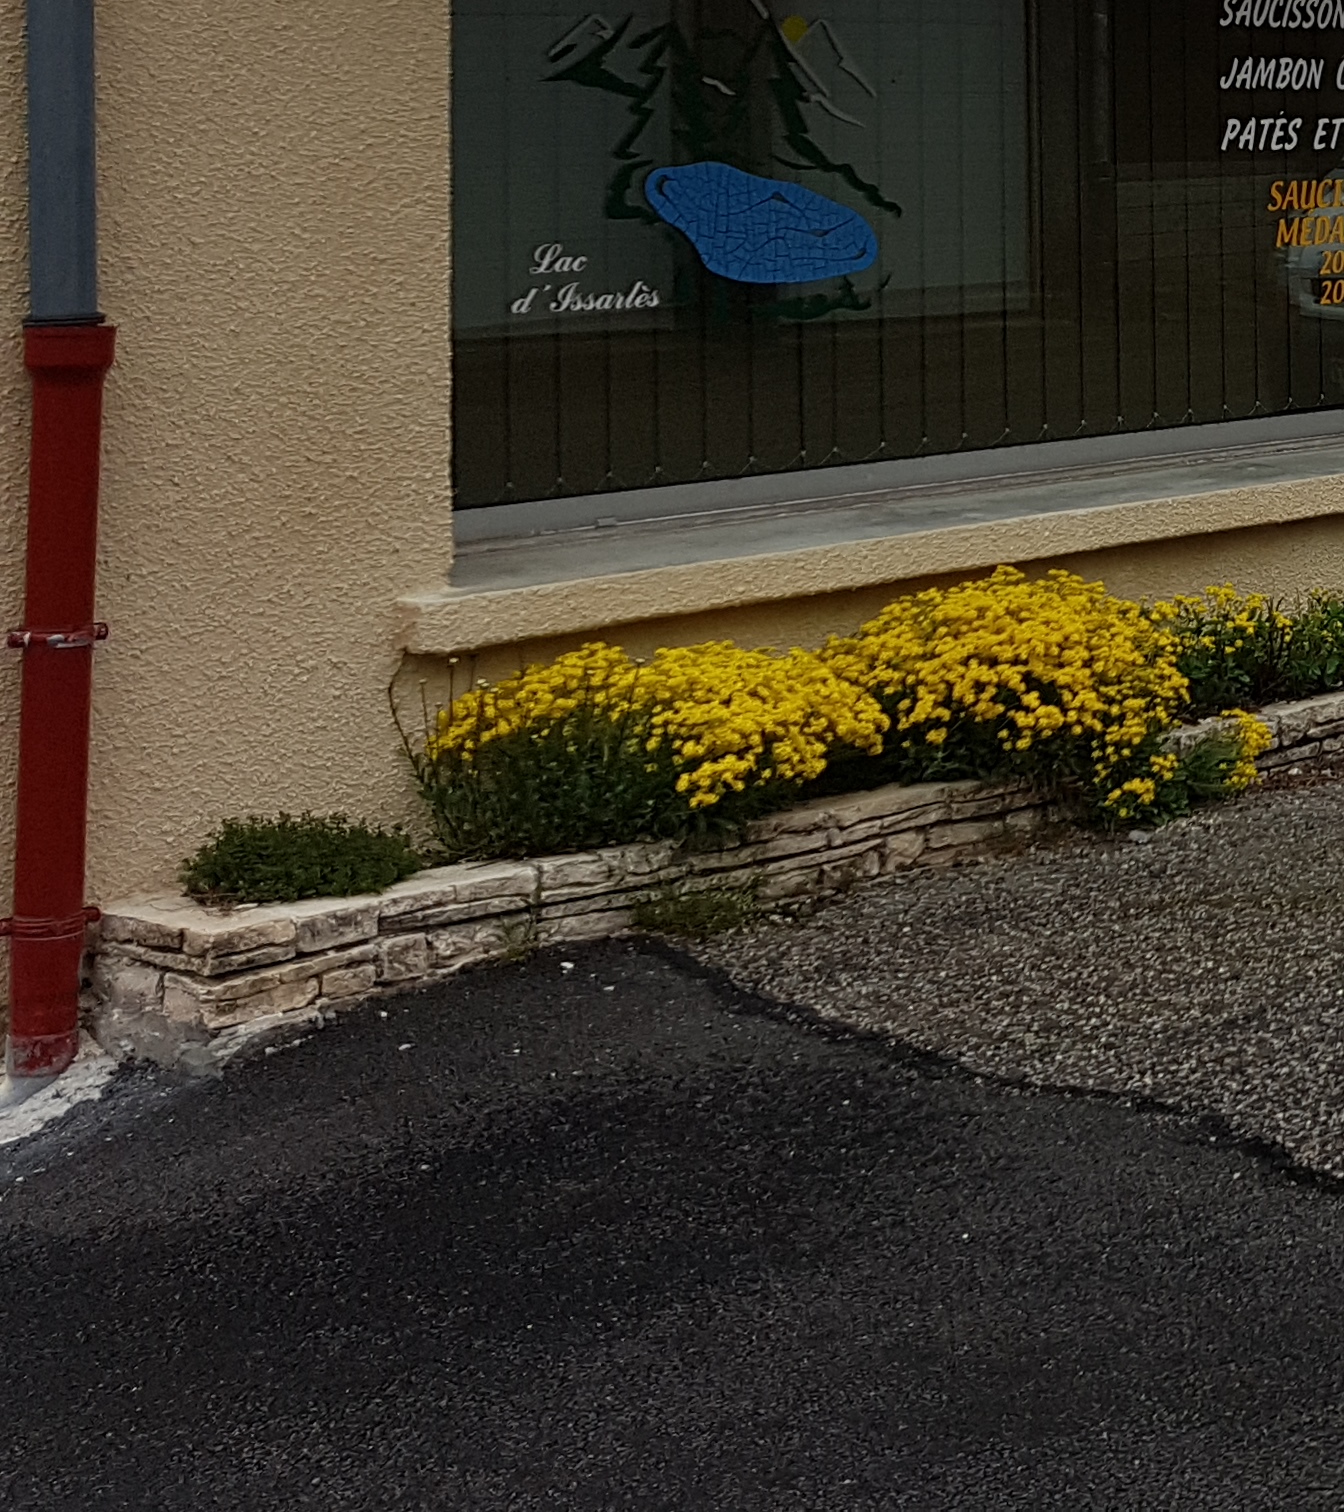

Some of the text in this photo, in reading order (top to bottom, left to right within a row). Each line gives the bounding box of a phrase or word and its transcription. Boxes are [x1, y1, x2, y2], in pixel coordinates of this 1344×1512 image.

[1219, 57, 1325, 91] JAMBON
[1220, 109, 1302, 151] PATÉS
[529, 243, 588, 275] Lac
